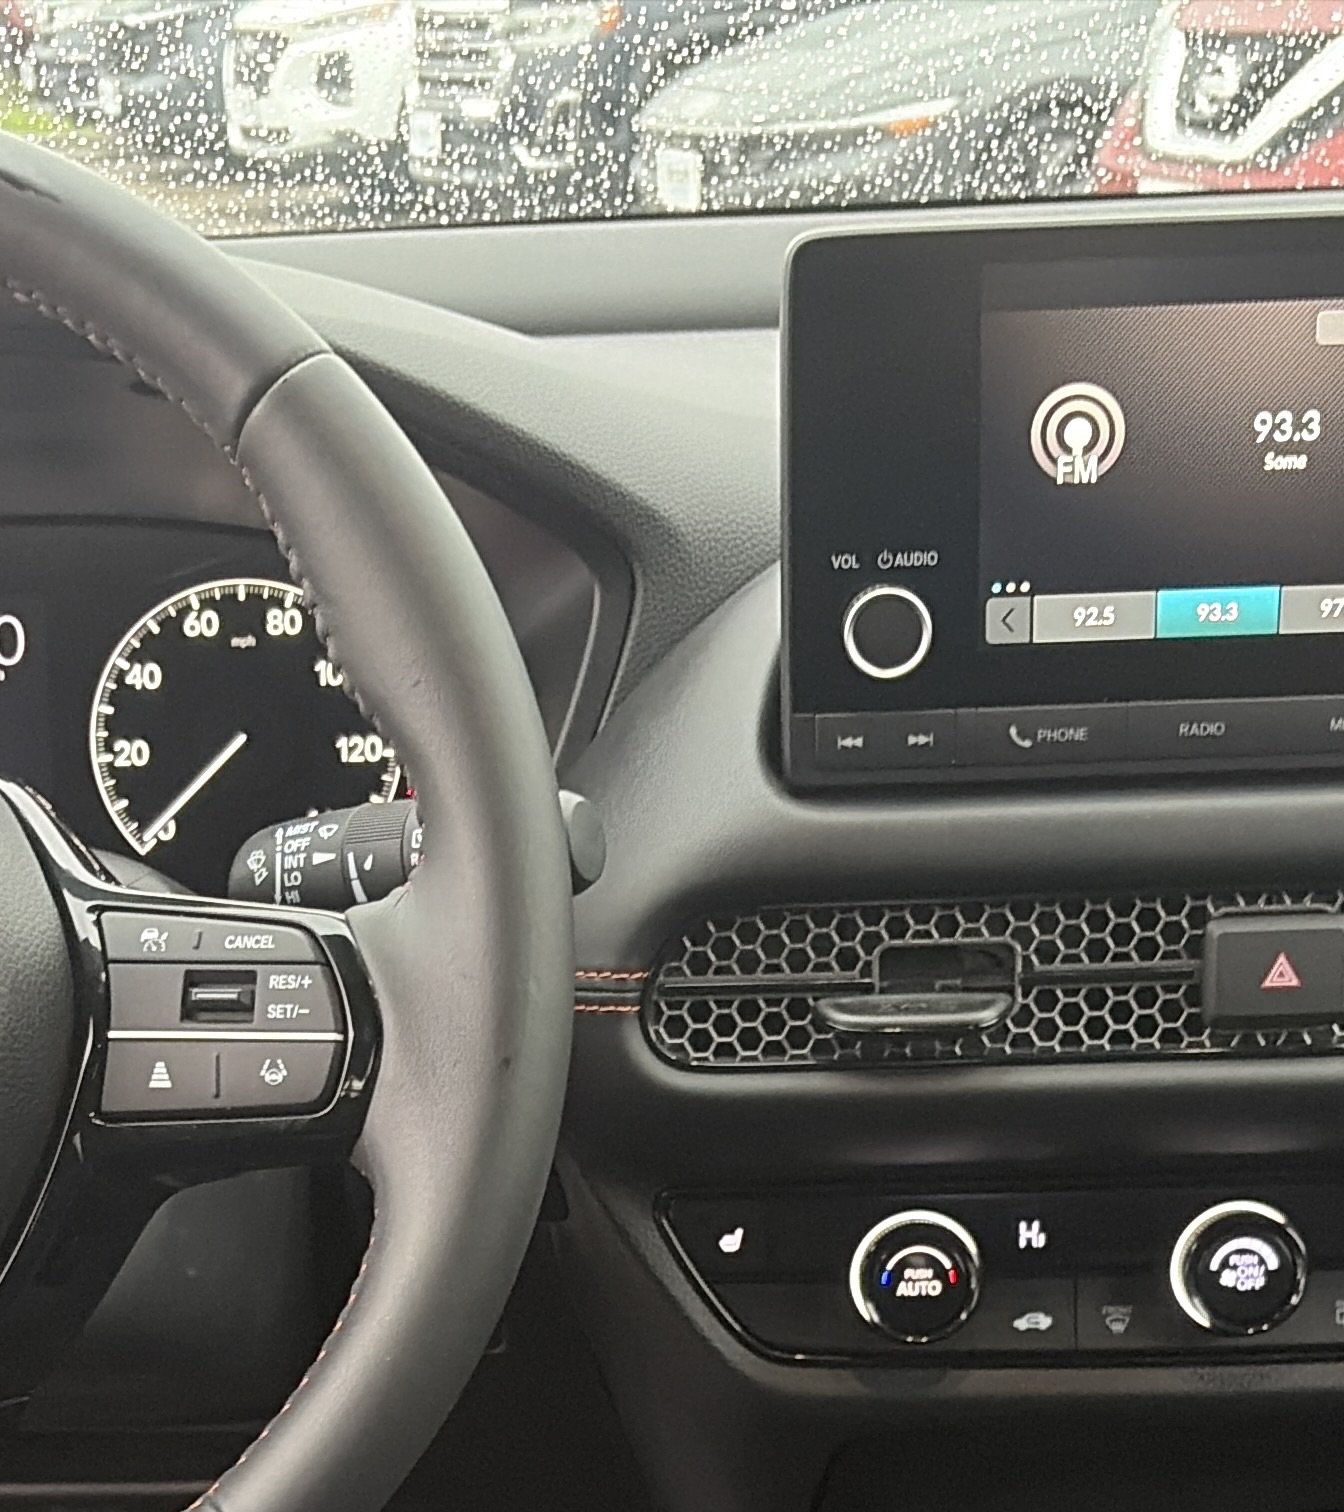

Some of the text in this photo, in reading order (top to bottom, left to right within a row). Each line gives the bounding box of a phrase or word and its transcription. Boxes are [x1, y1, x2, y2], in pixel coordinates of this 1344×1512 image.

[1253, 409, 1322, 444] 93.3
[1056, 454, 1099, 485] FM
[1263, 452, 1308, 472] Some
[830, 553, 861, 570] VOL
[893, 550, 939, 568] AUDIO
[1072, 605, 1116, 628] 92.5
[1195, 601, 1240, 624] 93.3
[183, 609, 220, 638] 60
[266, 608, 303, 636] 80
[124, 662, 163, 691] 40
[1037, 726, 1089, 743] PHONE
[1178, 721, 1226, 738] RADIO
[112, 739, 150, 768] 20
[335, 734, 383, 763] 120
[284, 820, 320, 838] MIST
[283, 837, 312, 853] OFF
[283, 853, 307, 870] INT
[283, 871, 302, 887] LO
[224, 934, 276, 950] CANCEL
[268, 974, 313, 990] RES/+
[1228, 1254, 1260, 1267] PUSH
[903, 1267, 935, 1280] PUSH
[895, 1280, 943, 1297] AUTO
[1236, 1276, 1266, 1292] OFF
